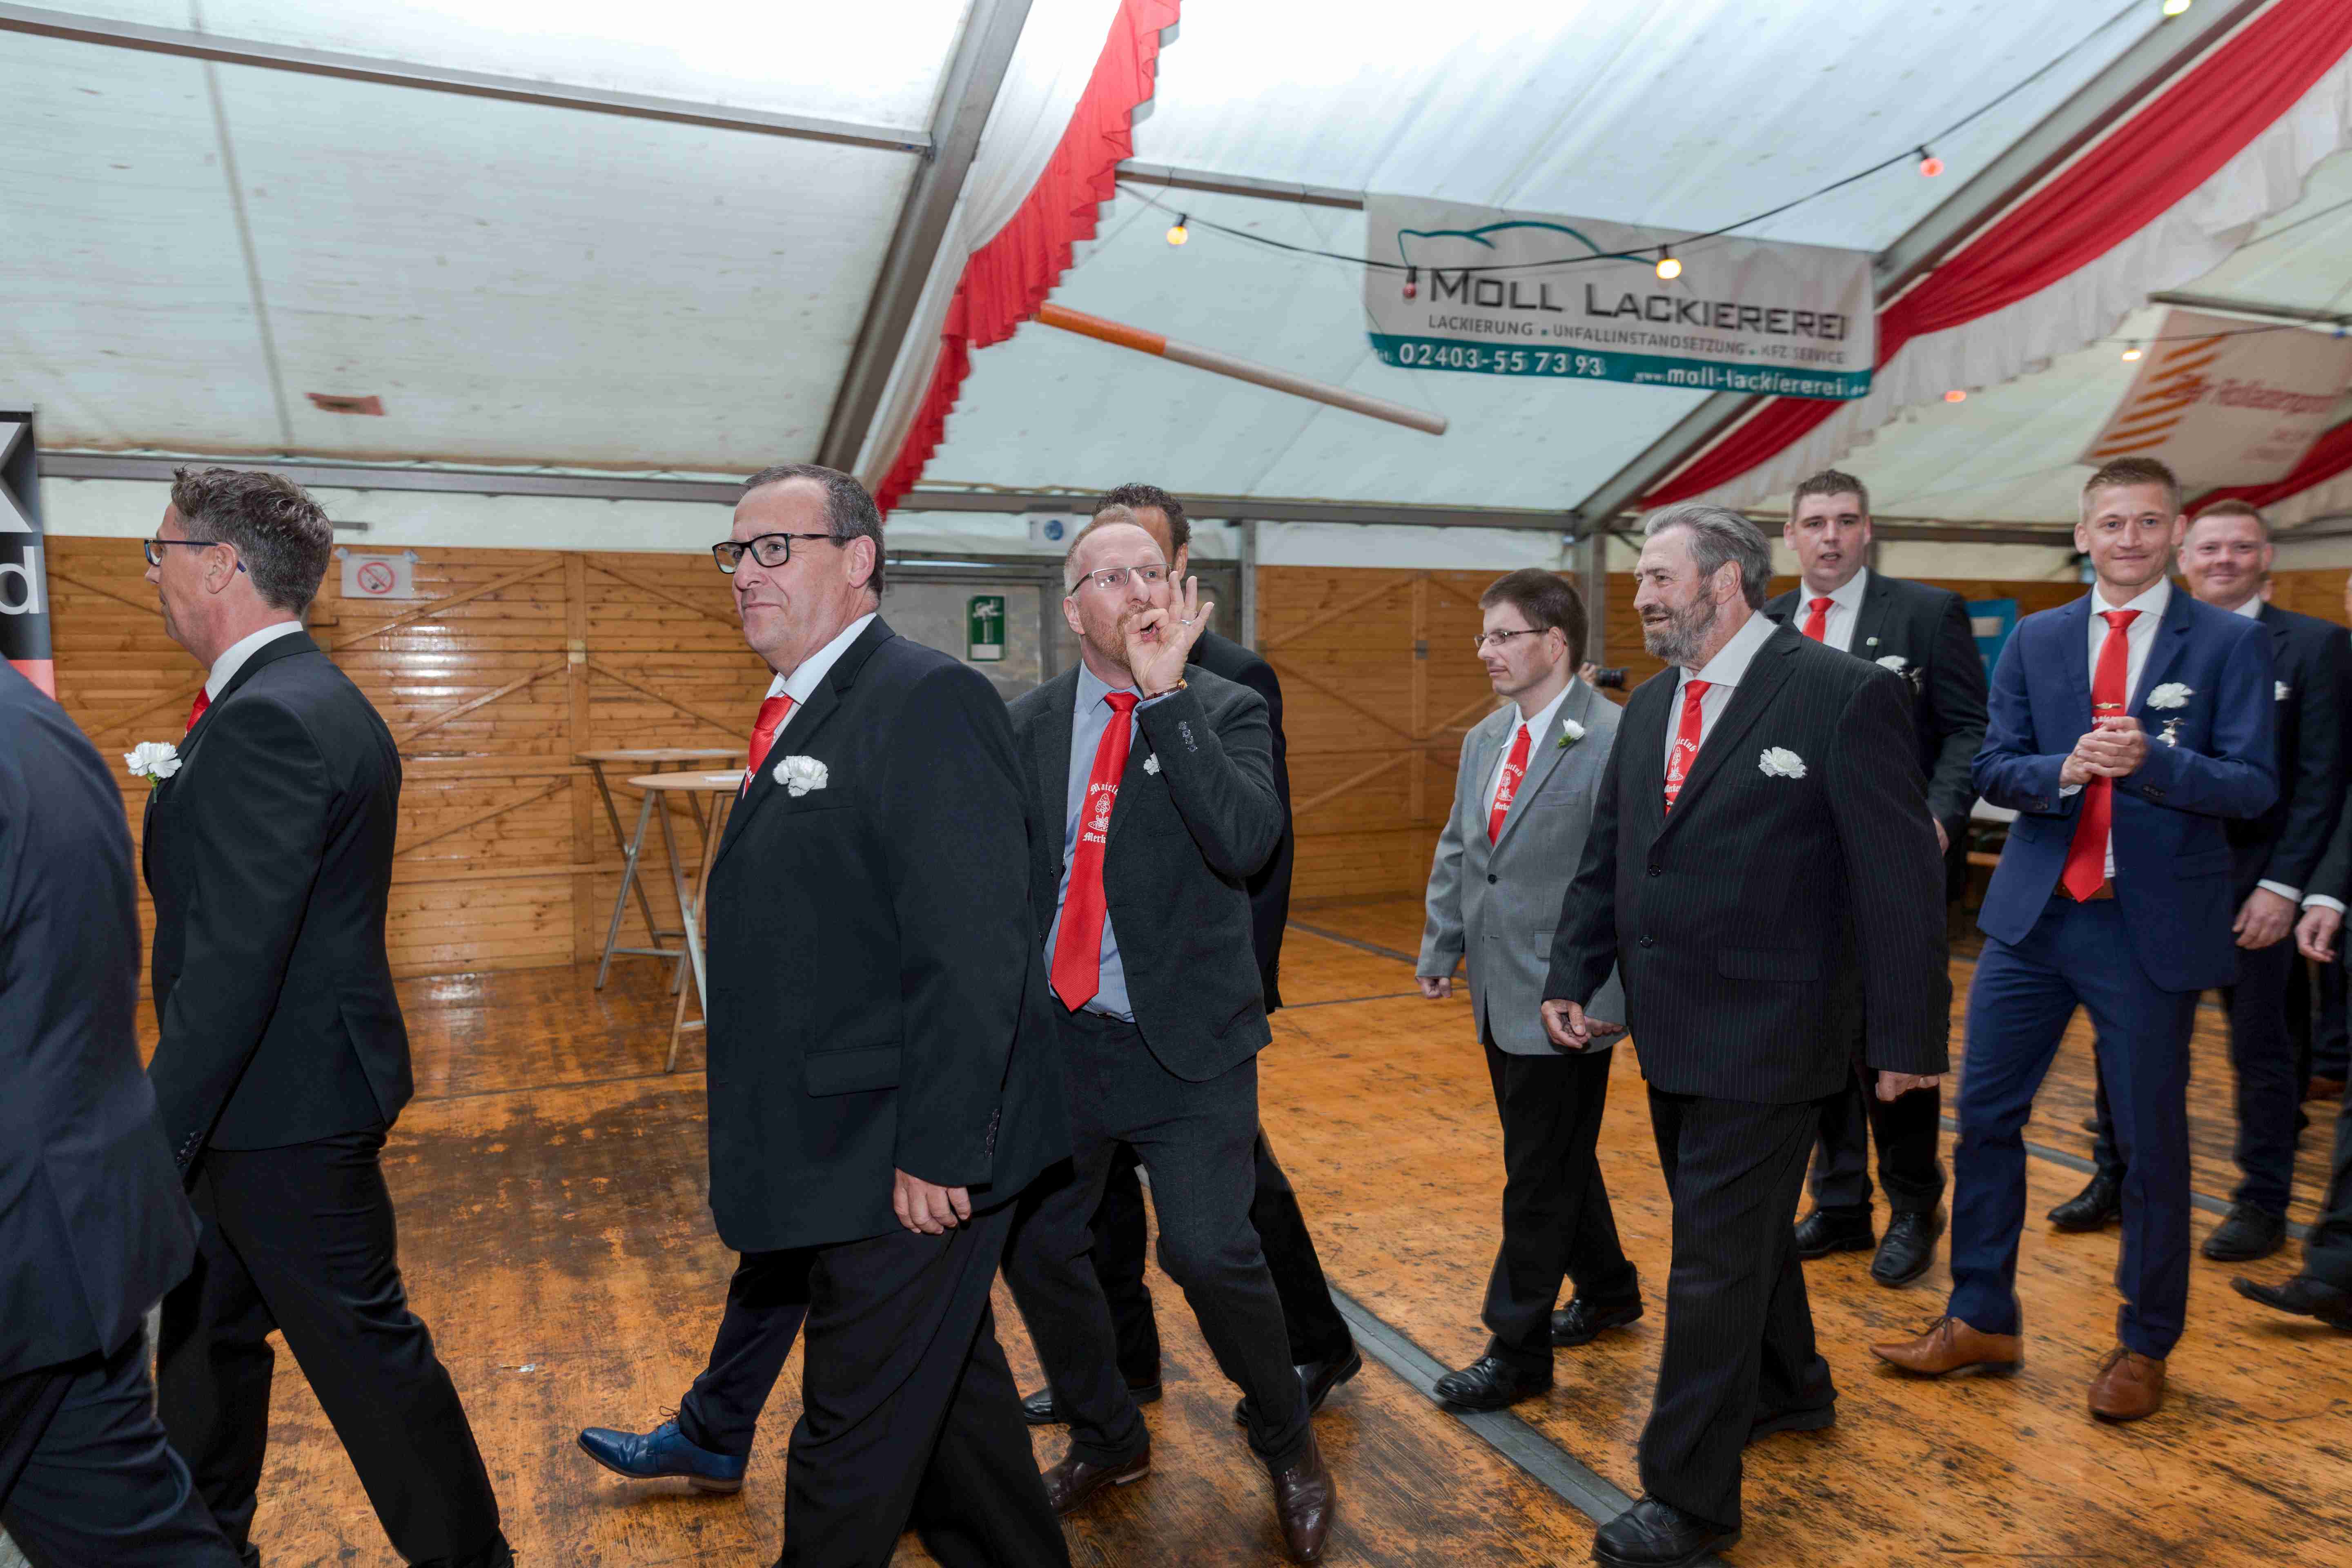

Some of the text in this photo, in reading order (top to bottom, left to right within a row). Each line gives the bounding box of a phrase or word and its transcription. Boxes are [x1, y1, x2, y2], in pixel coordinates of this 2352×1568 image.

[1430, 269, 1846, 341] MOLL LACKIEREREI
[1429, 314, 1534, 336] LACKIERUNG
[1553, 324, 1746, 356] UNFALLINSTANDSETZUNG
